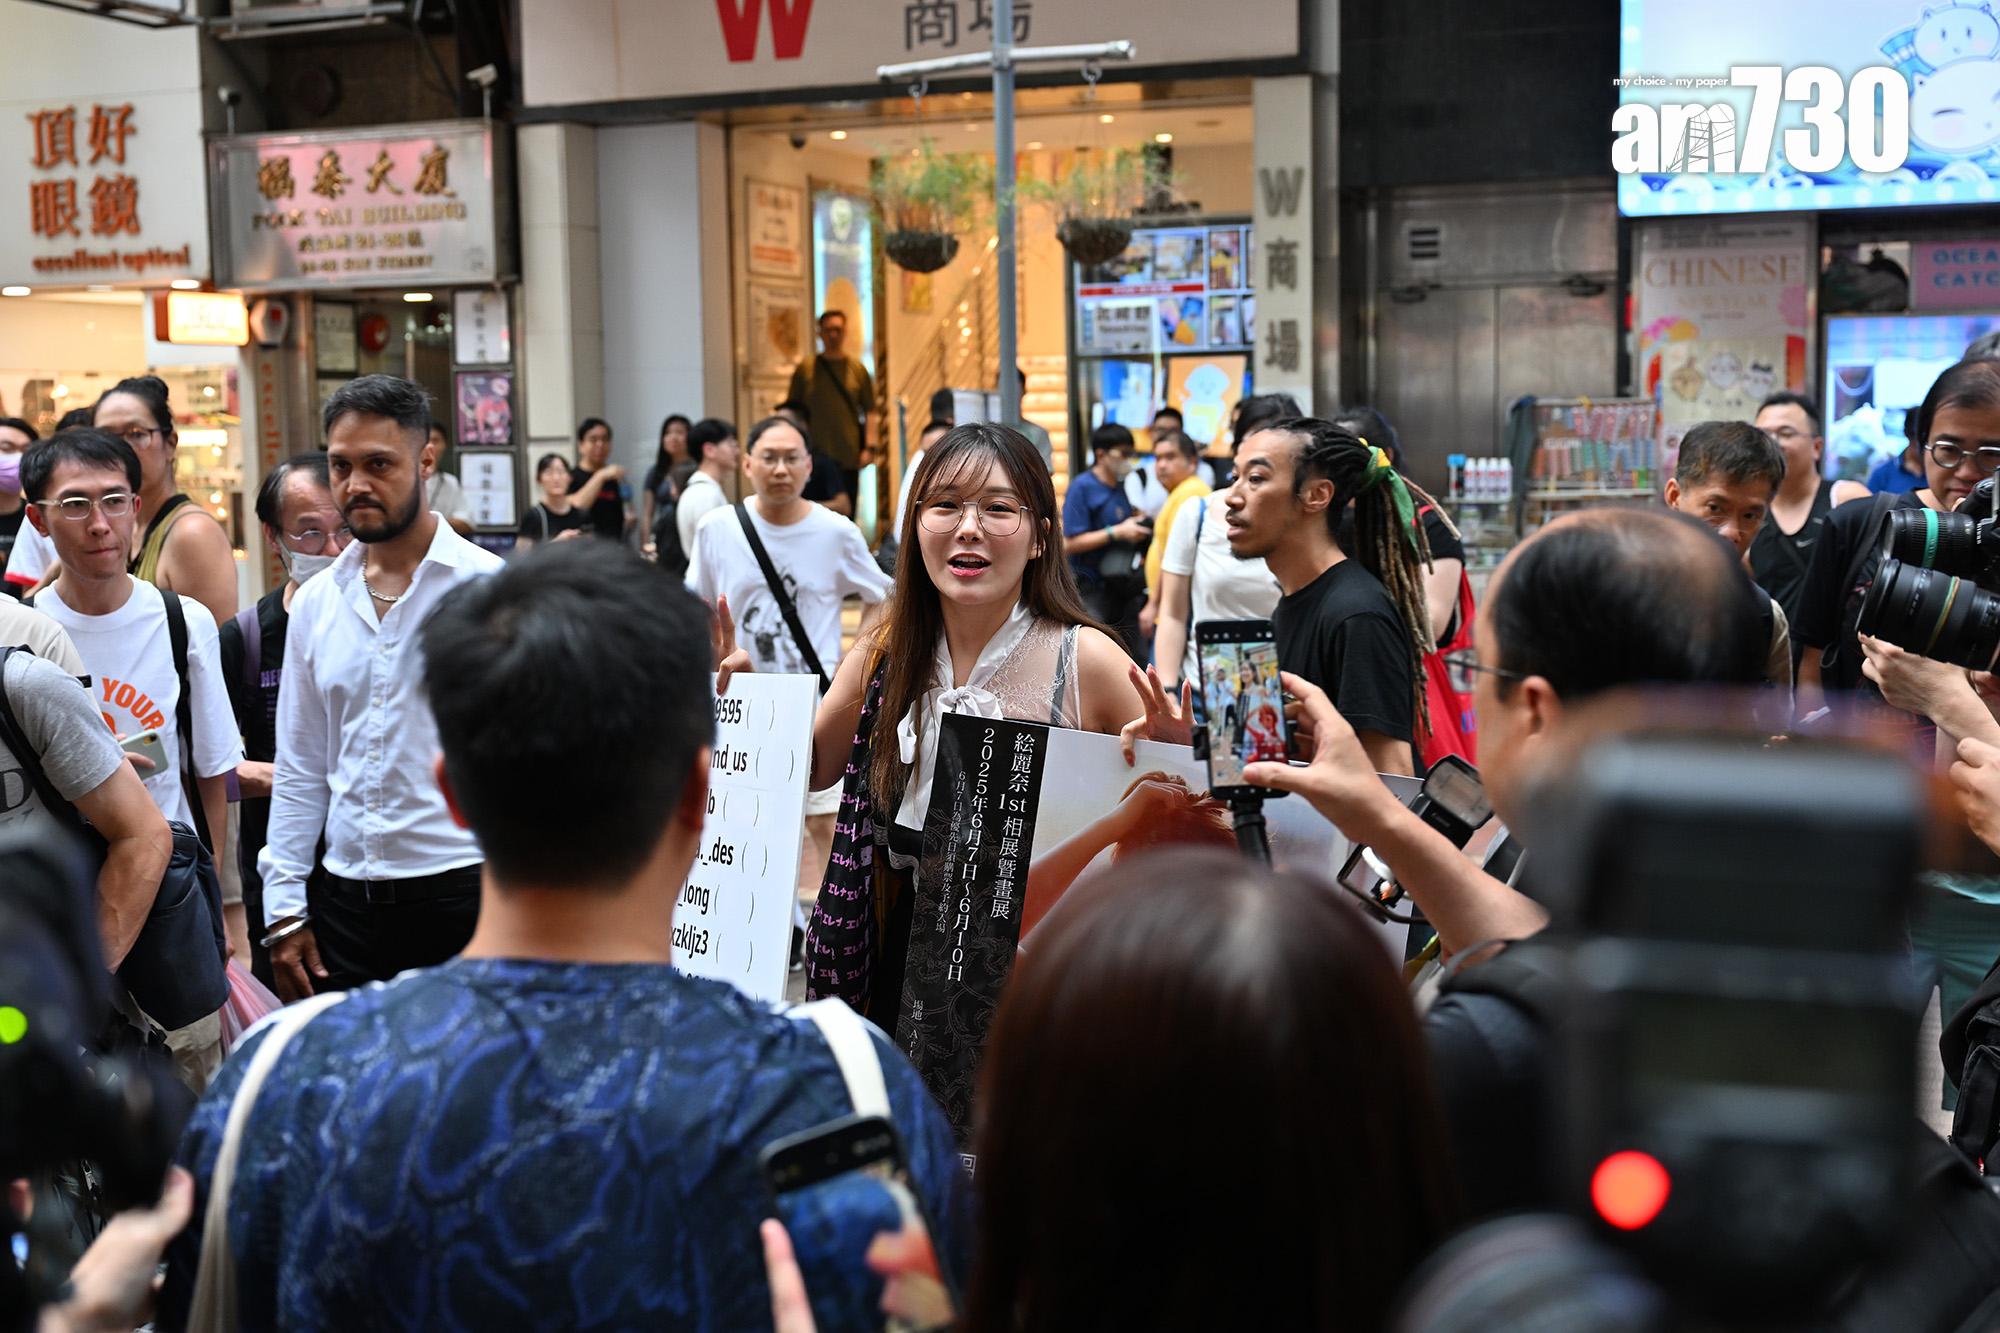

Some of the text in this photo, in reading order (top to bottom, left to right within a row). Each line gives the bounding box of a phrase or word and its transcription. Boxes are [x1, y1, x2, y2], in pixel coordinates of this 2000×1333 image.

[26, 102, 137, 170] 頂好
[29, 172, 141, 240] 眼鏡
[102, 677, 165, 731] YOUR
[713, 697, 742, 724] 9595
[711, 743, 747, 776] nd_us
